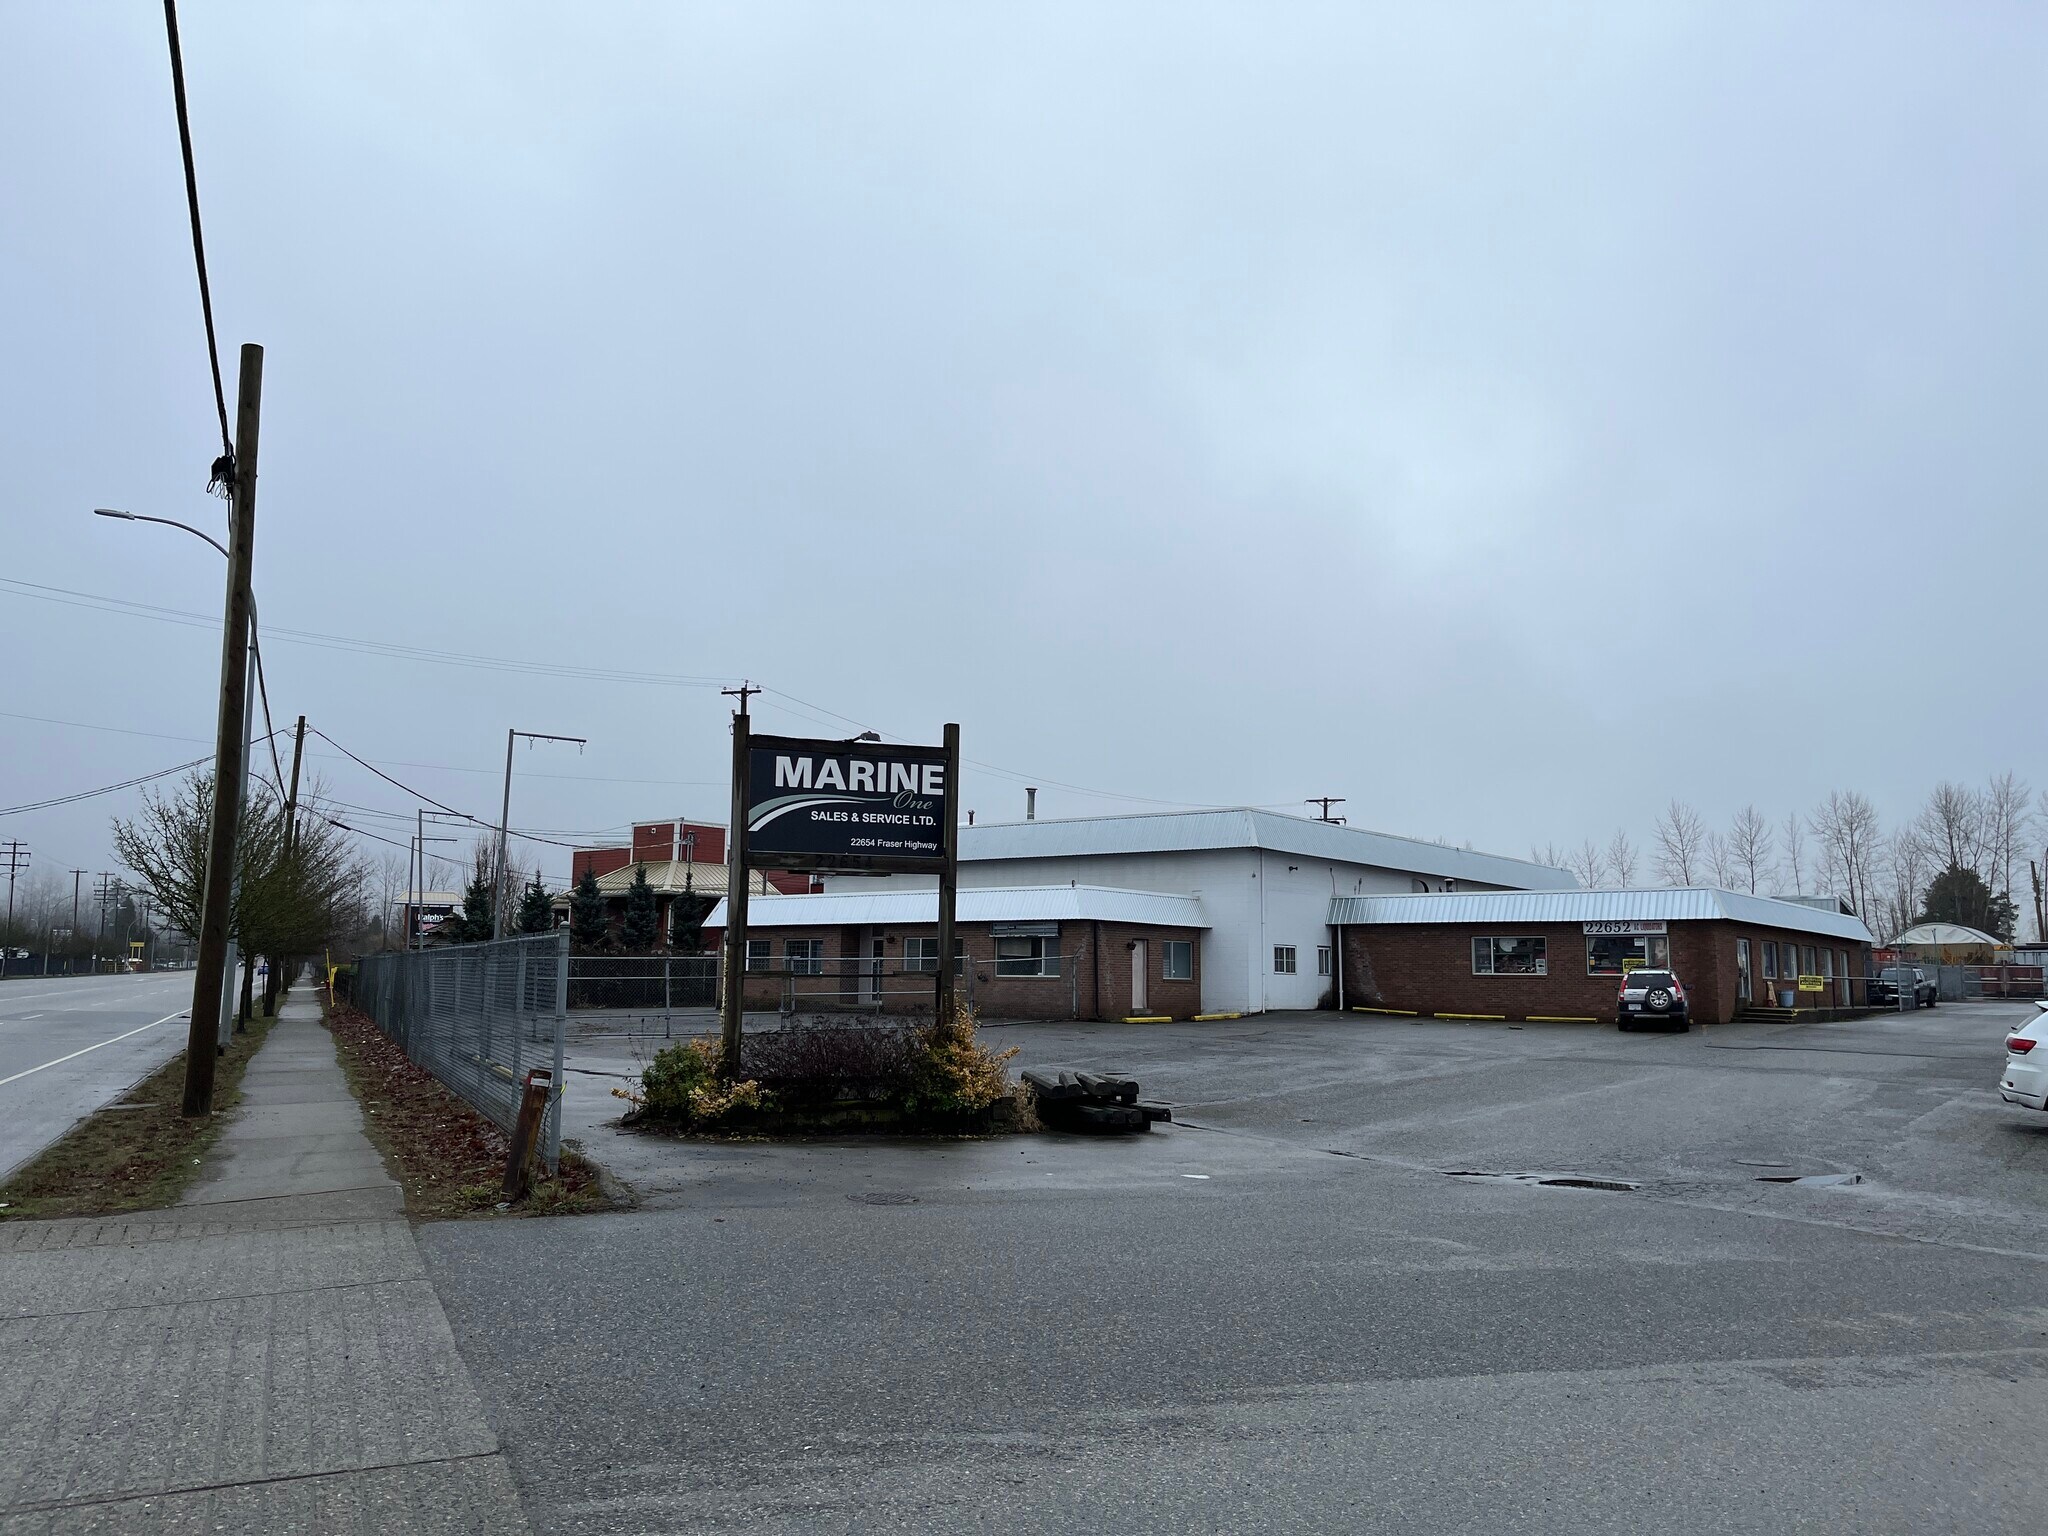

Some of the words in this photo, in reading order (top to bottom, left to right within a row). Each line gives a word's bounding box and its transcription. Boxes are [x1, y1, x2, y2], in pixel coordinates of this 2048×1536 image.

[775, 755, 945, 796] MARINE
[893, 789, 934, 810] One
[810, 810, 849, 822] SALES
[851, 812, 860, 823] &
[862, 812, 910, 825] SERVICE
[912, 815, 937, 826] LTD.
[850, 837, 875, 847] 22654
[877, 839, 903, 848] Fraser
[904, 840, 938, 851] Highway
[417, 913, 444, 922] alph's
[1586, 921, 1631, 933] 22652
